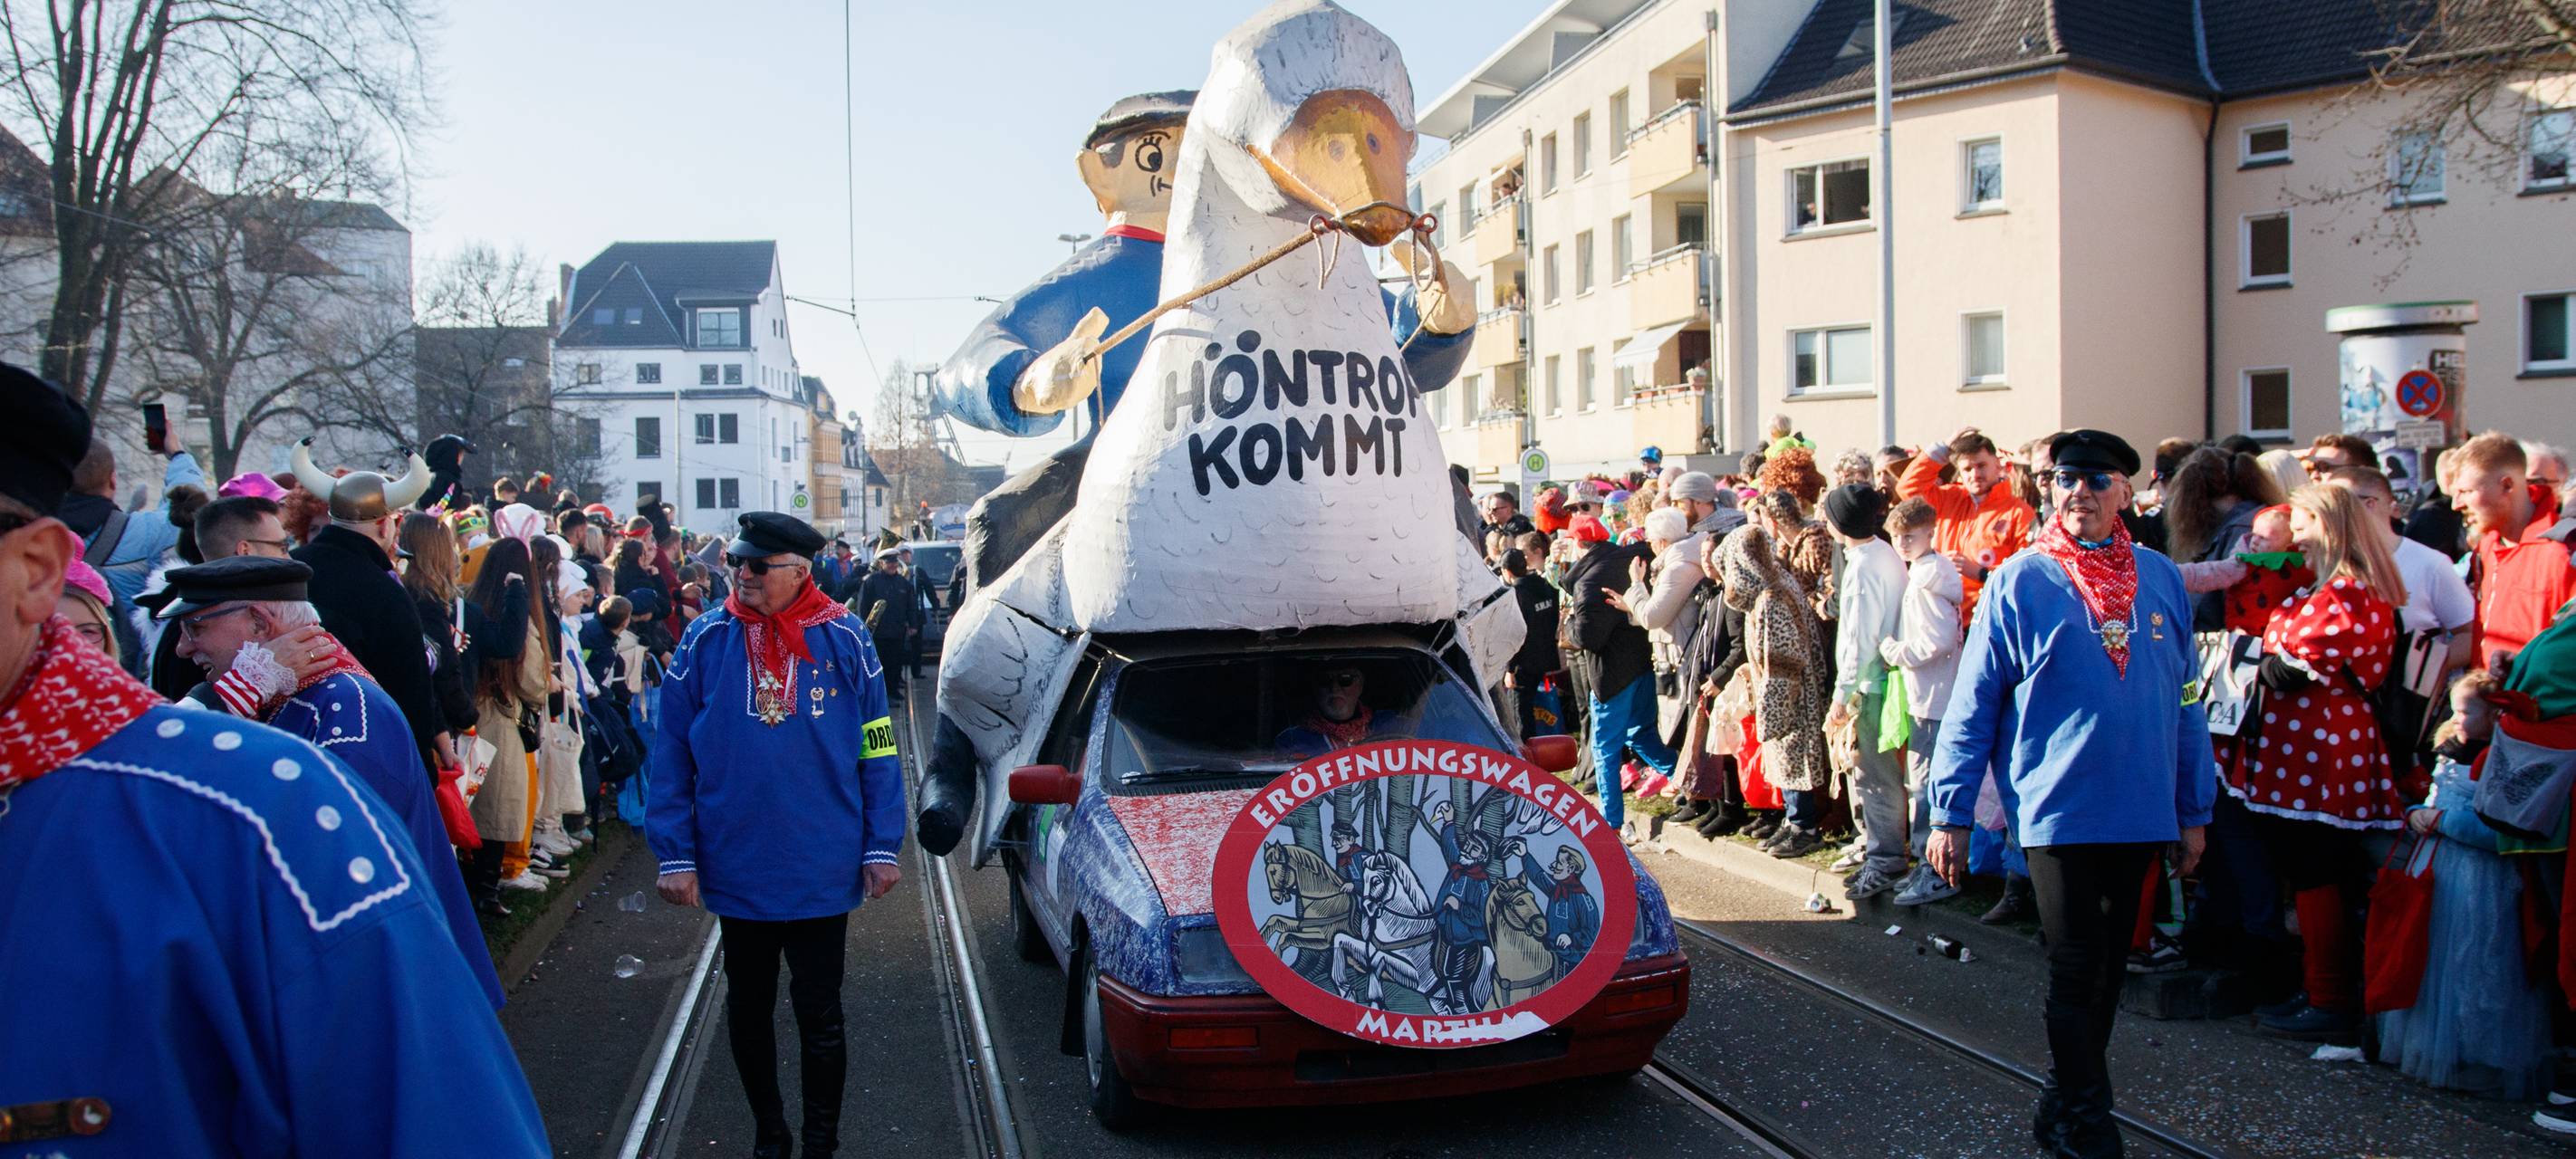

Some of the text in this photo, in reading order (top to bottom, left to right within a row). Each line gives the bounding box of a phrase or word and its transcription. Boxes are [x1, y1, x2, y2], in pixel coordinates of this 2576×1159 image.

[1188, 413, 1407, 496] KOMMT
[2206, 701, 2237, 725] C&A
[1249, 746, 1598, 838] ERÖFFNUNGSWAGEN
